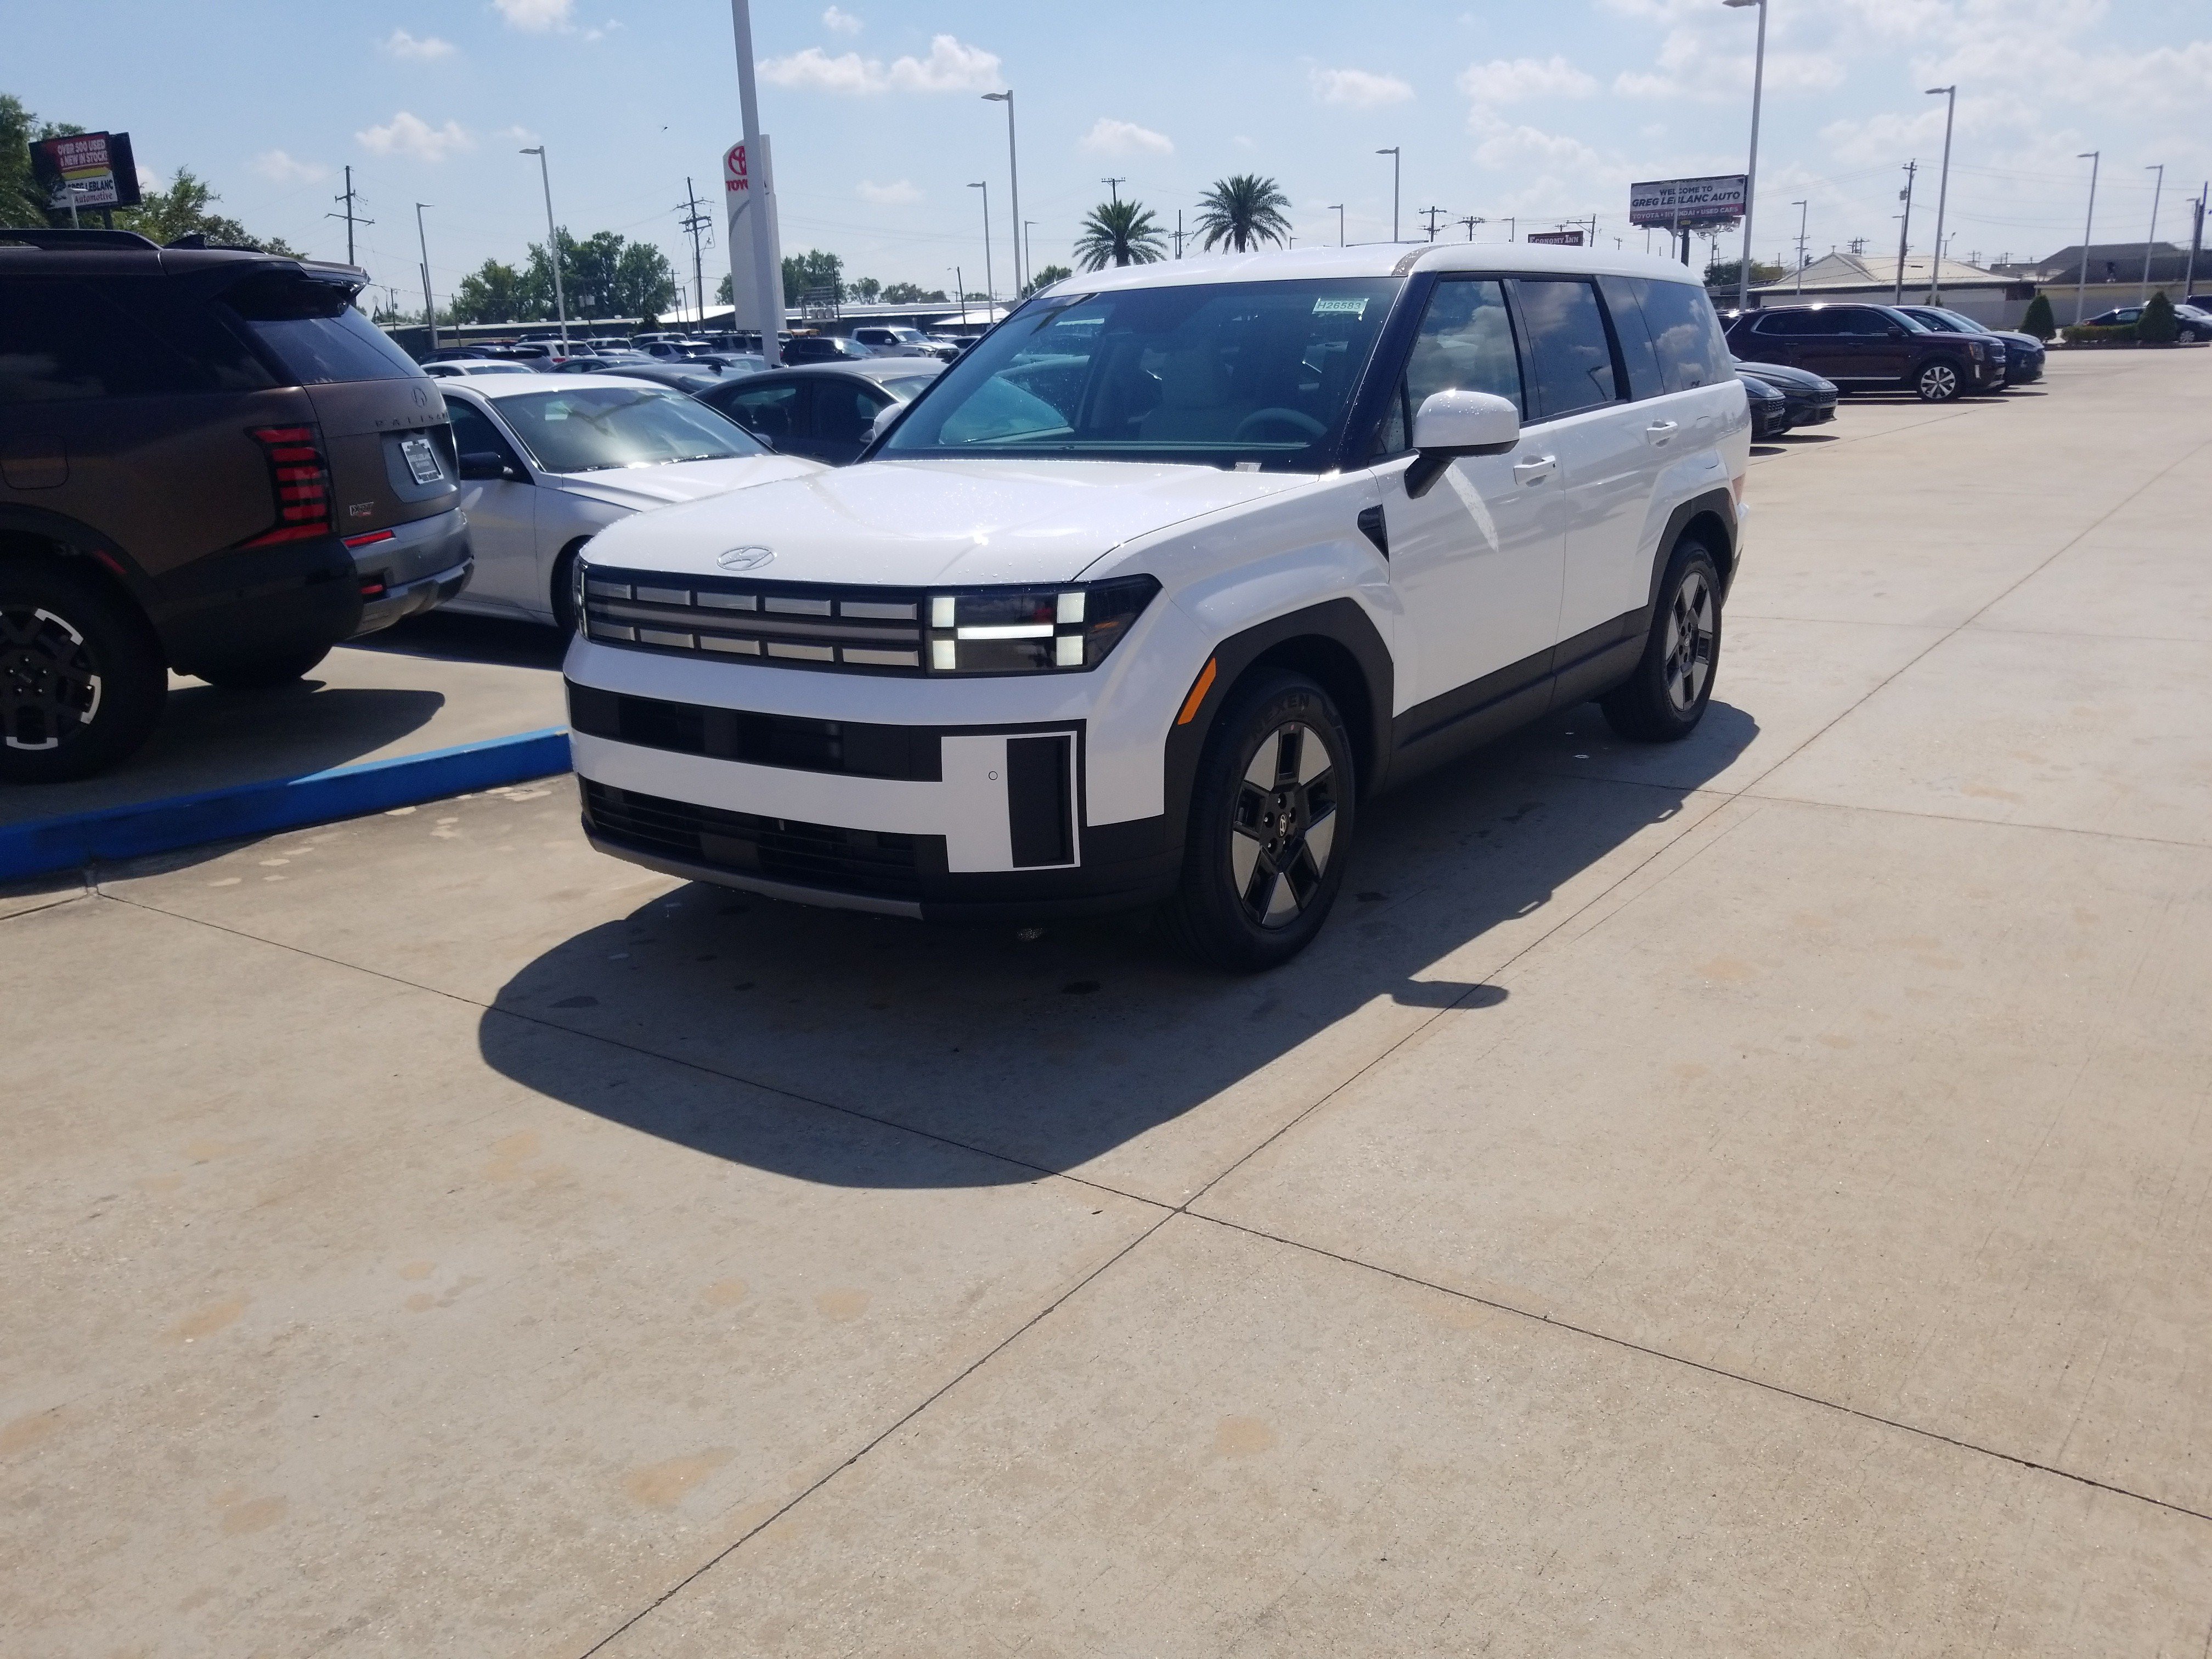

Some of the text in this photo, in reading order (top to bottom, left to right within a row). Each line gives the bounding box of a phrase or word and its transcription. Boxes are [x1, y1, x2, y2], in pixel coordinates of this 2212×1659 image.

[58, 139, 105, 156] OVER 500 USED
[65, 154, 78, 166] NEW
[78, 153, 86, 165] IN
[85, 179, 114, 191] LEBLANC
[74, 191, 112, 203] Automotive
[1632, 198, 1659, 207] GREG
[1710, 191, 1740, 201] AUTO
